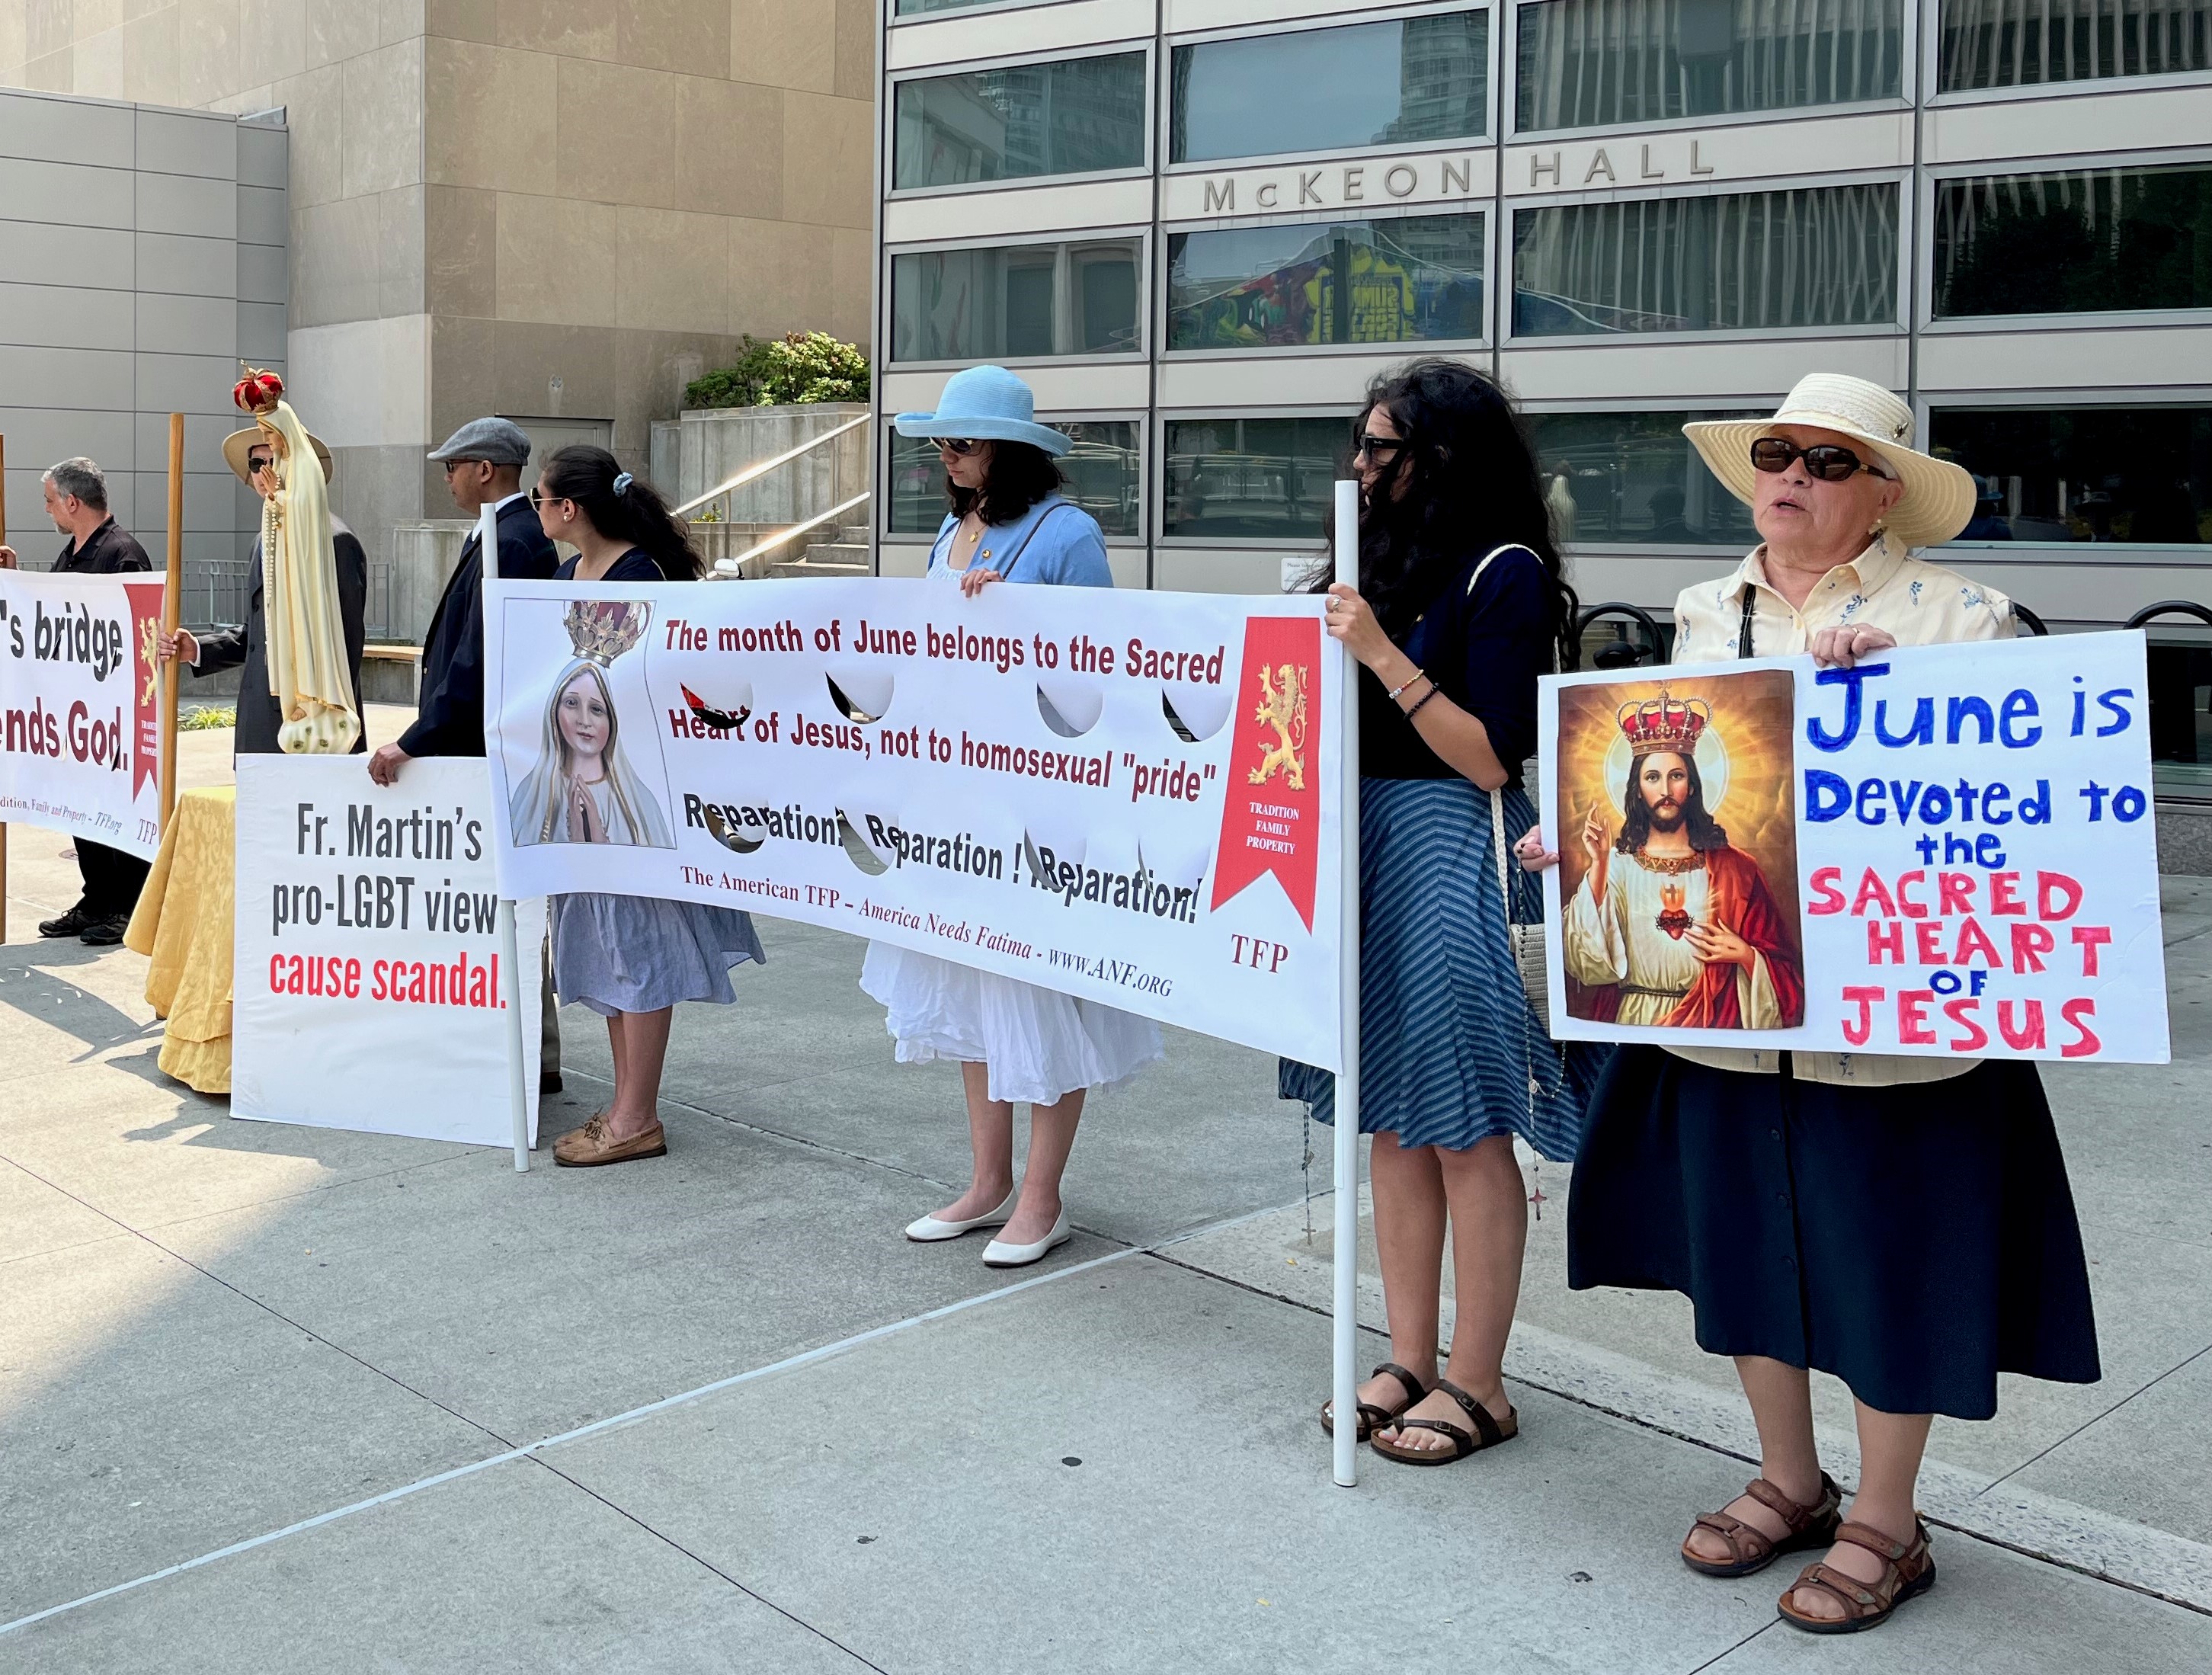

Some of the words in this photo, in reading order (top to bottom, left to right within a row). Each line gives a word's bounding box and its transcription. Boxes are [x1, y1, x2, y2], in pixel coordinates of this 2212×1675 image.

[1531, 139, 1714, 186] HALL
[35, 601, 123, 682] bridge
[665, 620, 707, 651] The
[719, 620, 804, 652] month
[815, 620, 840, 652] of
[853, 620, 917, 655] June
[927, 623, 1024, 674] belongs
[1034, 632, 1058, 668] to
[1069, 635, 1114, 674] the
[1126, 638, 1224, 684] Sacred
[0, 697, 60, 757] nds
[67, 700, 128, 771] God.
[1806, 661, 2043, 753] June
[2070, 675, 2135, 738] is
[754, 711, 778, 743] of
[790, 713, 871, 761] Jesus,
[881, 725, 919, 759] not
[929, 727, 952, 763] to
[962, 730, 1112, 788] homosexual
[1124, 752, 1216, 802] "pride"
[31, 799, 50, 817] Family
[51, 805, 62, 816] and
[62, 805, 87, 825] Property
[94, 812, 123, 836] TFP.org
[1249, 802, 1299, 821] TRADITION
[1804, 768, 2052, 826] Devoted
[2079, 780, 2146, 824] to
[136, 818, 158, 845] TFP
[296, 802, 335, 856] Fr.
[347, 804, 482, 861] Martin's
[1246, 835, 1295, 855] PROPERTY
[1256, 820, 1291, 836] FAMILY
[1916, 831, 2006, 870] the
[273, 874, 415, 936] pro-LGBT
[680, 866, 714, 887] The
[719, 871, 799, 901] American
[805, 885, 840, 908] TFP
[859, 898, 920, 930] America
[924, 913, 972, 943] Needs
[975, 925, 1032, 959] Fatima
[1807, 866, 2083, 921] SACRED
[1231, 934, 1288, 974] TFP
[1868, 915, 2112, 978] HEART
[270, 953, 361, 999] cause
[371, 951, 506, 1009] scandal.
[1929, 969, 1986, 997] OF
[1842, 985, 2102, 1058] JESUS
